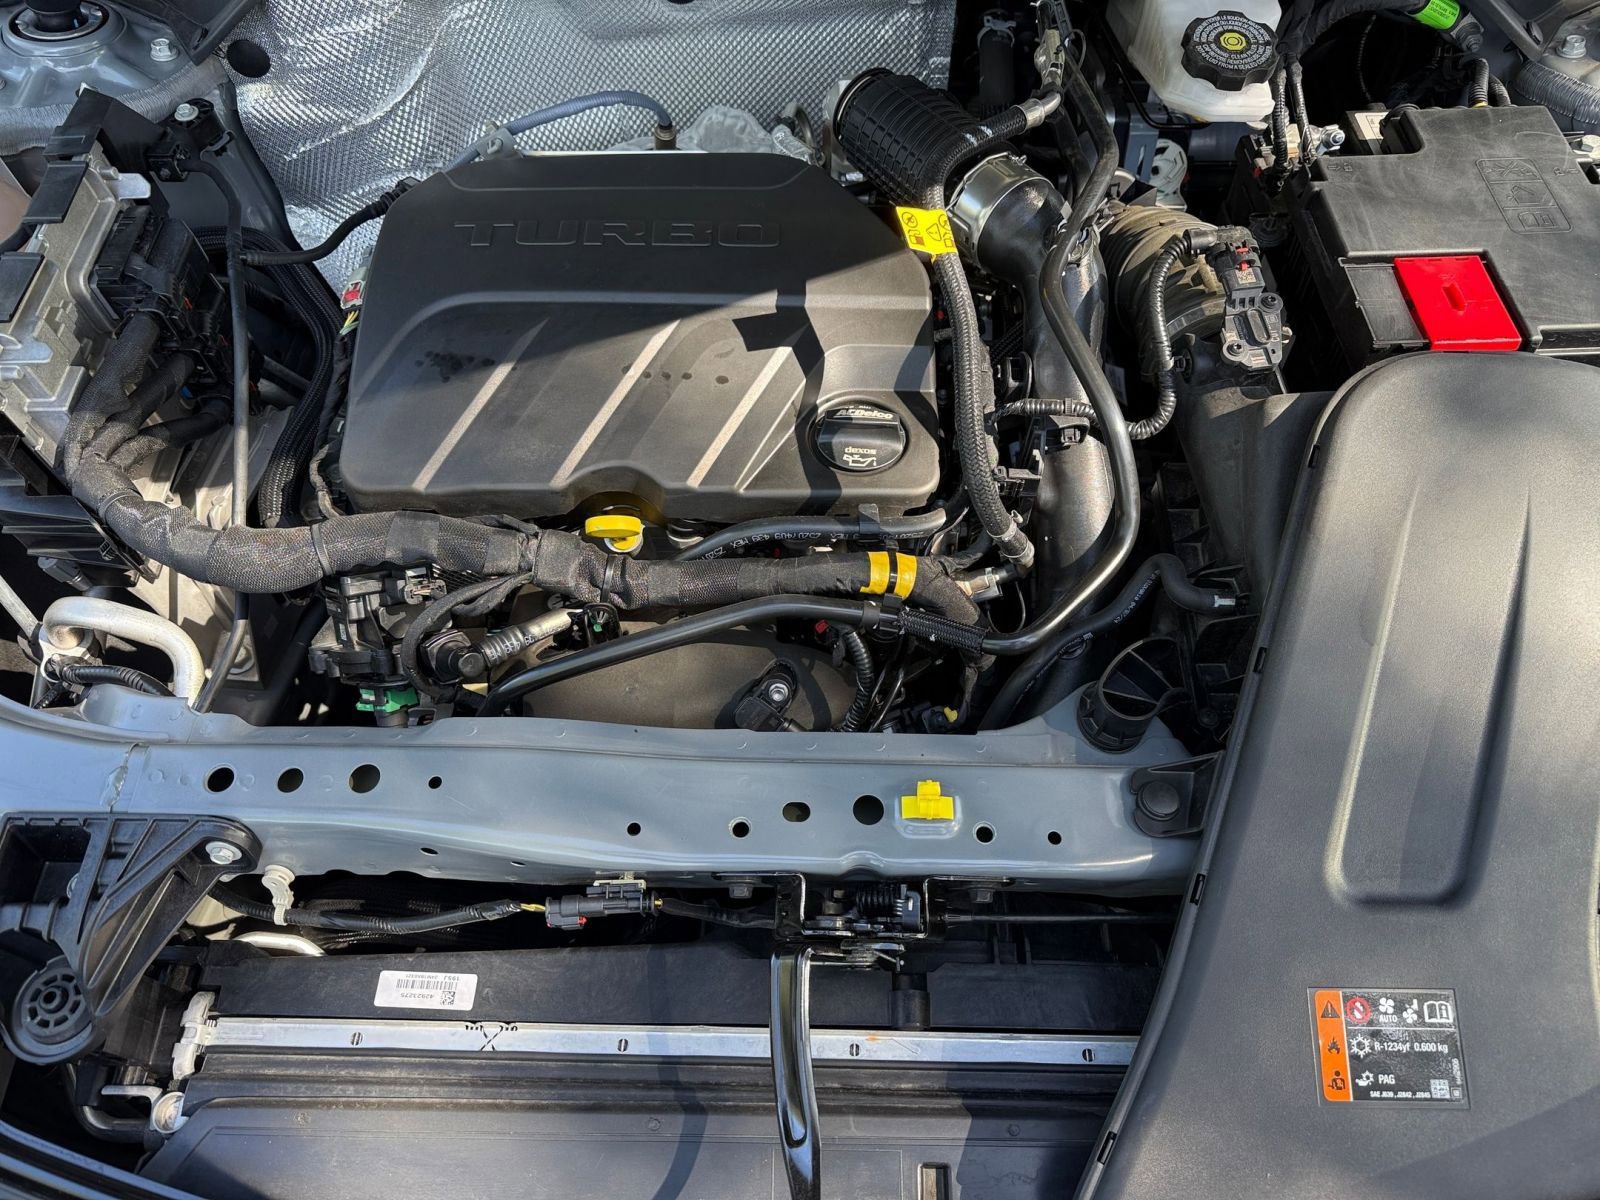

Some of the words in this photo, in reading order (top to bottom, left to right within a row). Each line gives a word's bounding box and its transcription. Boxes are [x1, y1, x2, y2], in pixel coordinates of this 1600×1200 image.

[453, 219, 780, 248] TURBO
[835, 408, 894, 419] ACDelco
[844, 446, 877, 455] dexos
[730, 537, 749, 548] MEX
[1379, 1014, 1398, 1023] AUTO
[1374, 1041, 1410, 1053] R-1234yf
[1414, 1042, 1436, 1052] 0.600
[1438, 1043, 1449, 1054] kg
[1378, 1074, 1396, 1085] PAG
